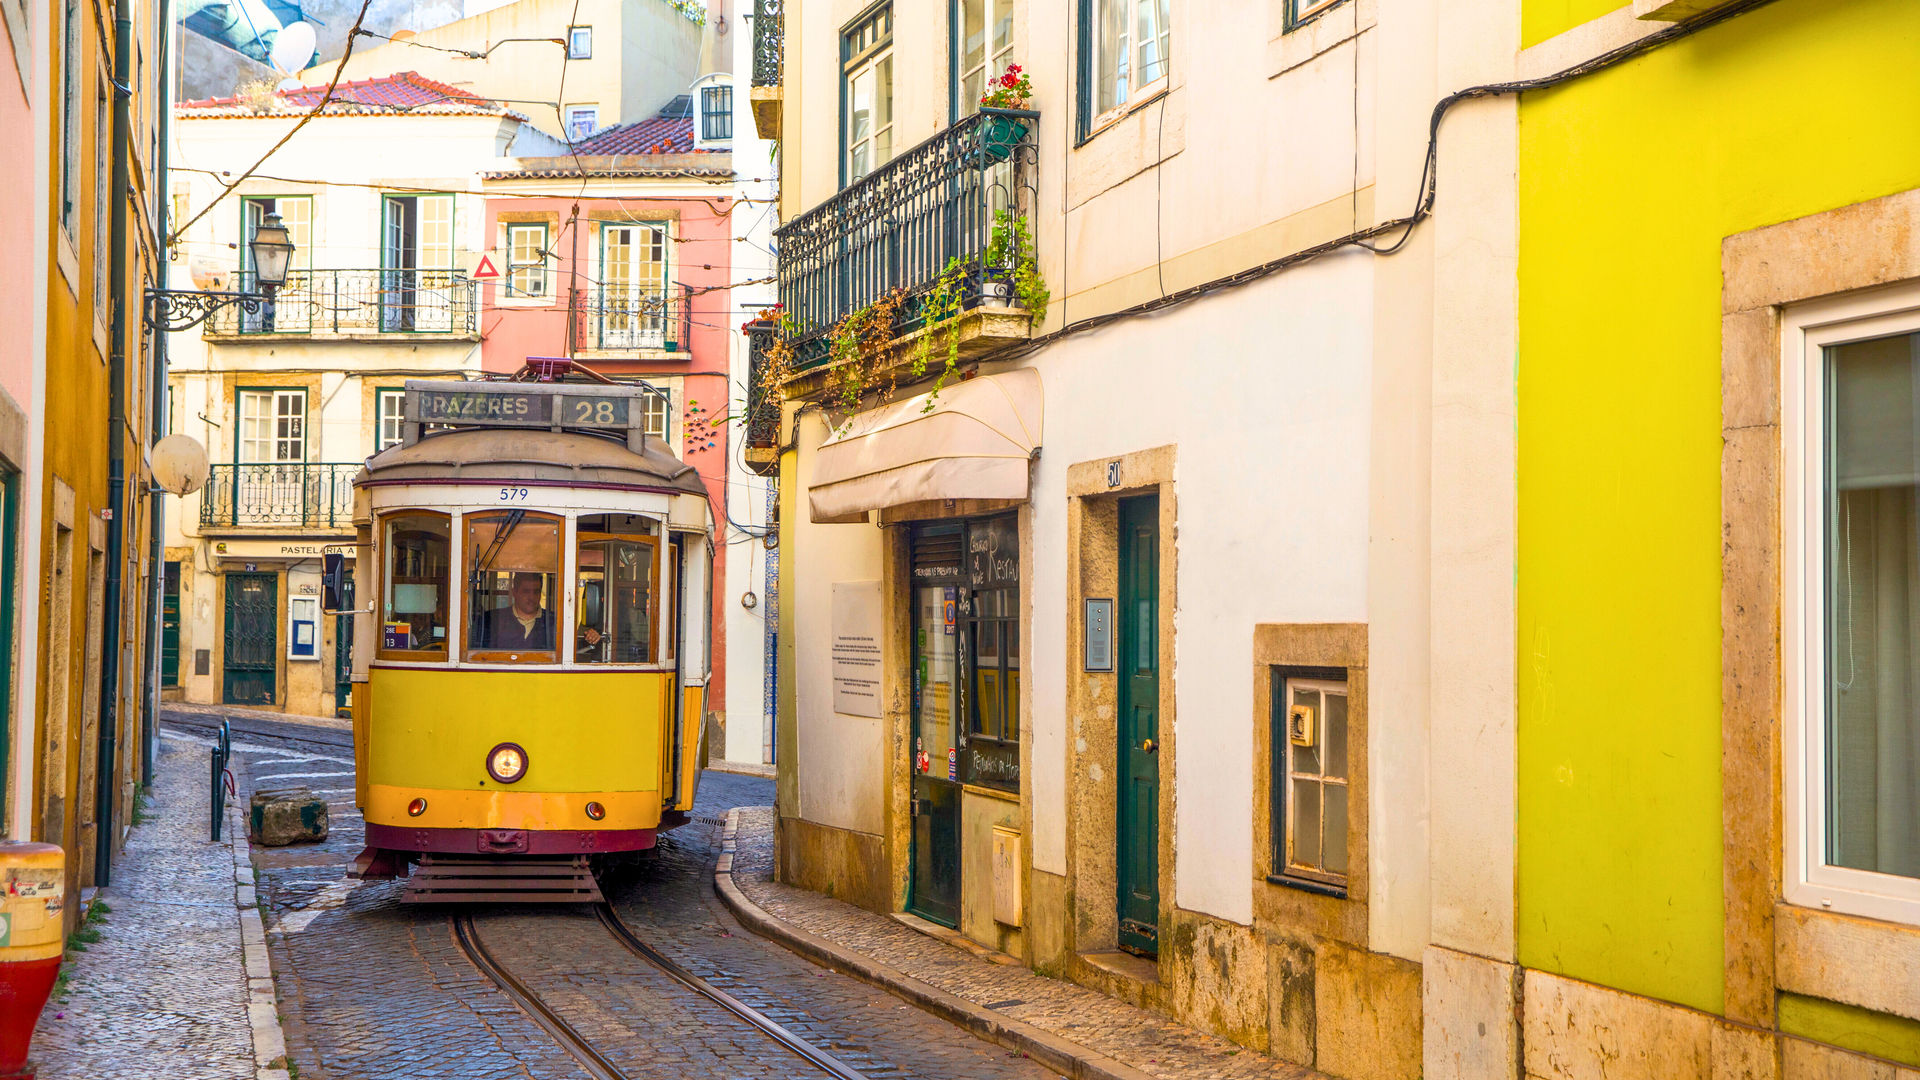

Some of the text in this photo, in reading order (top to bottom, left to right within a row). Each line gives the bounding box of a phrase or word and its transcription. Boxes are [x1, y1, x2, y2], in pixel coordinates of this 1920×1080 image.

[421, 395, 529, 416] PRAZERES
[575, 401, 615, 425] 28
[1108, 463, 1120, 486] 50
[500, 488, 528, 500] 579
[385, 638, 396, 647] 13
